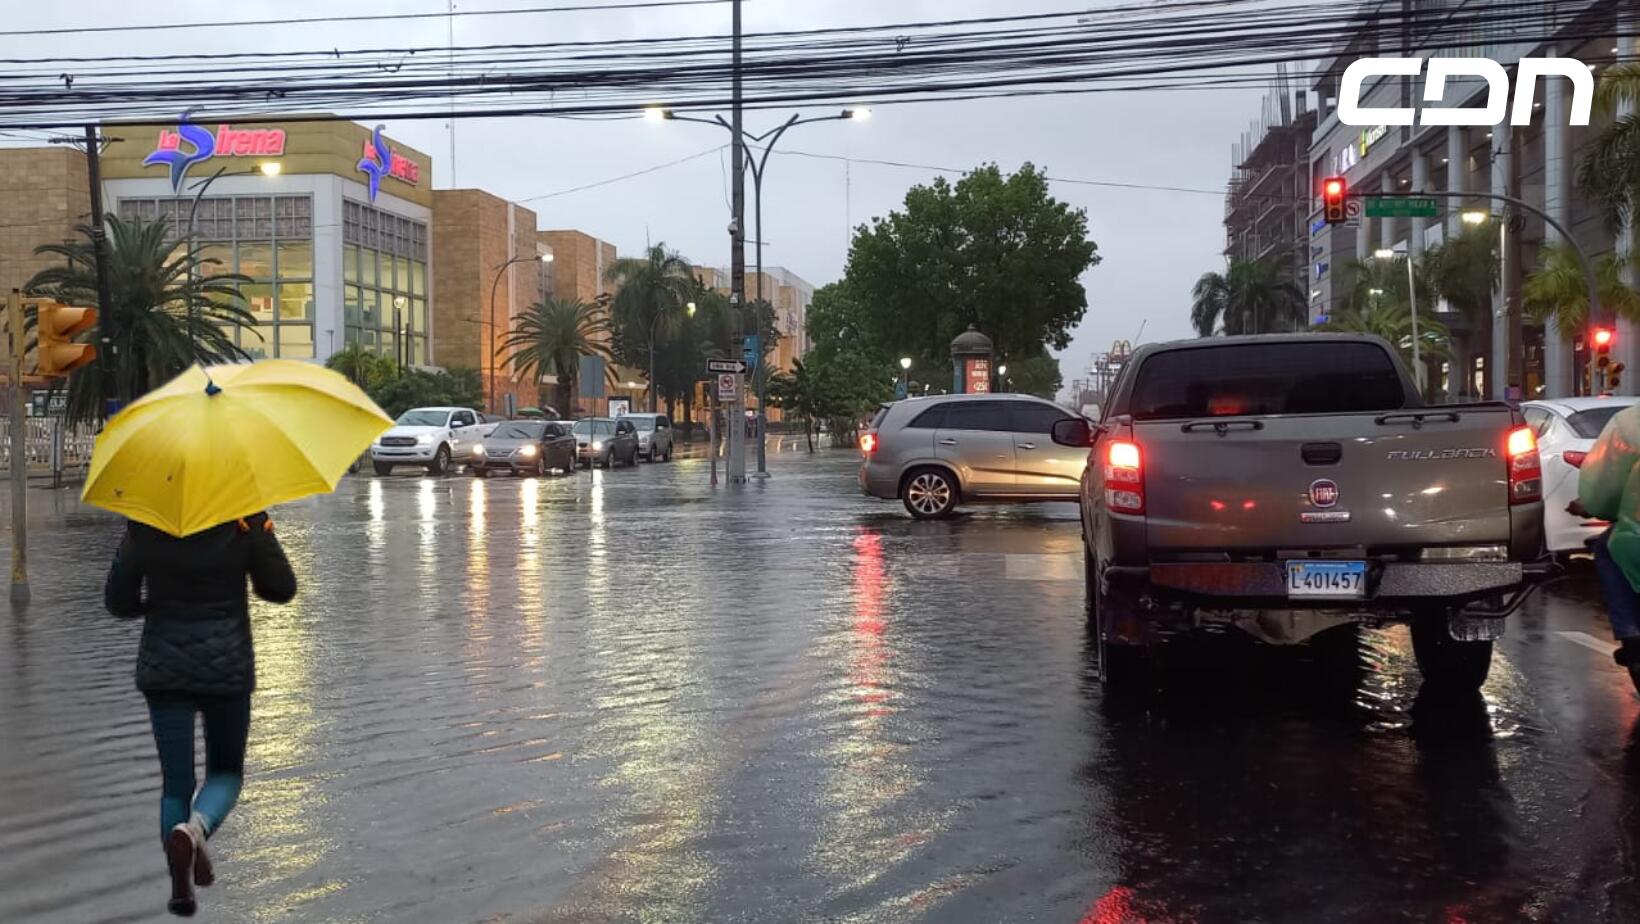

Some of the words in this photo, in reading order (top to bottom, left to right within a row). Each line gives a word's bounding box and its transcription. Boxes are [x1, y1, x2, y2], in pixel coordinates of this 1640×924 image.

[1387, 447, 1497, 461] FULLBACK
[1315, 487, 1334, 502] FIAT
[1291, 571, 1361, 590] L401457
